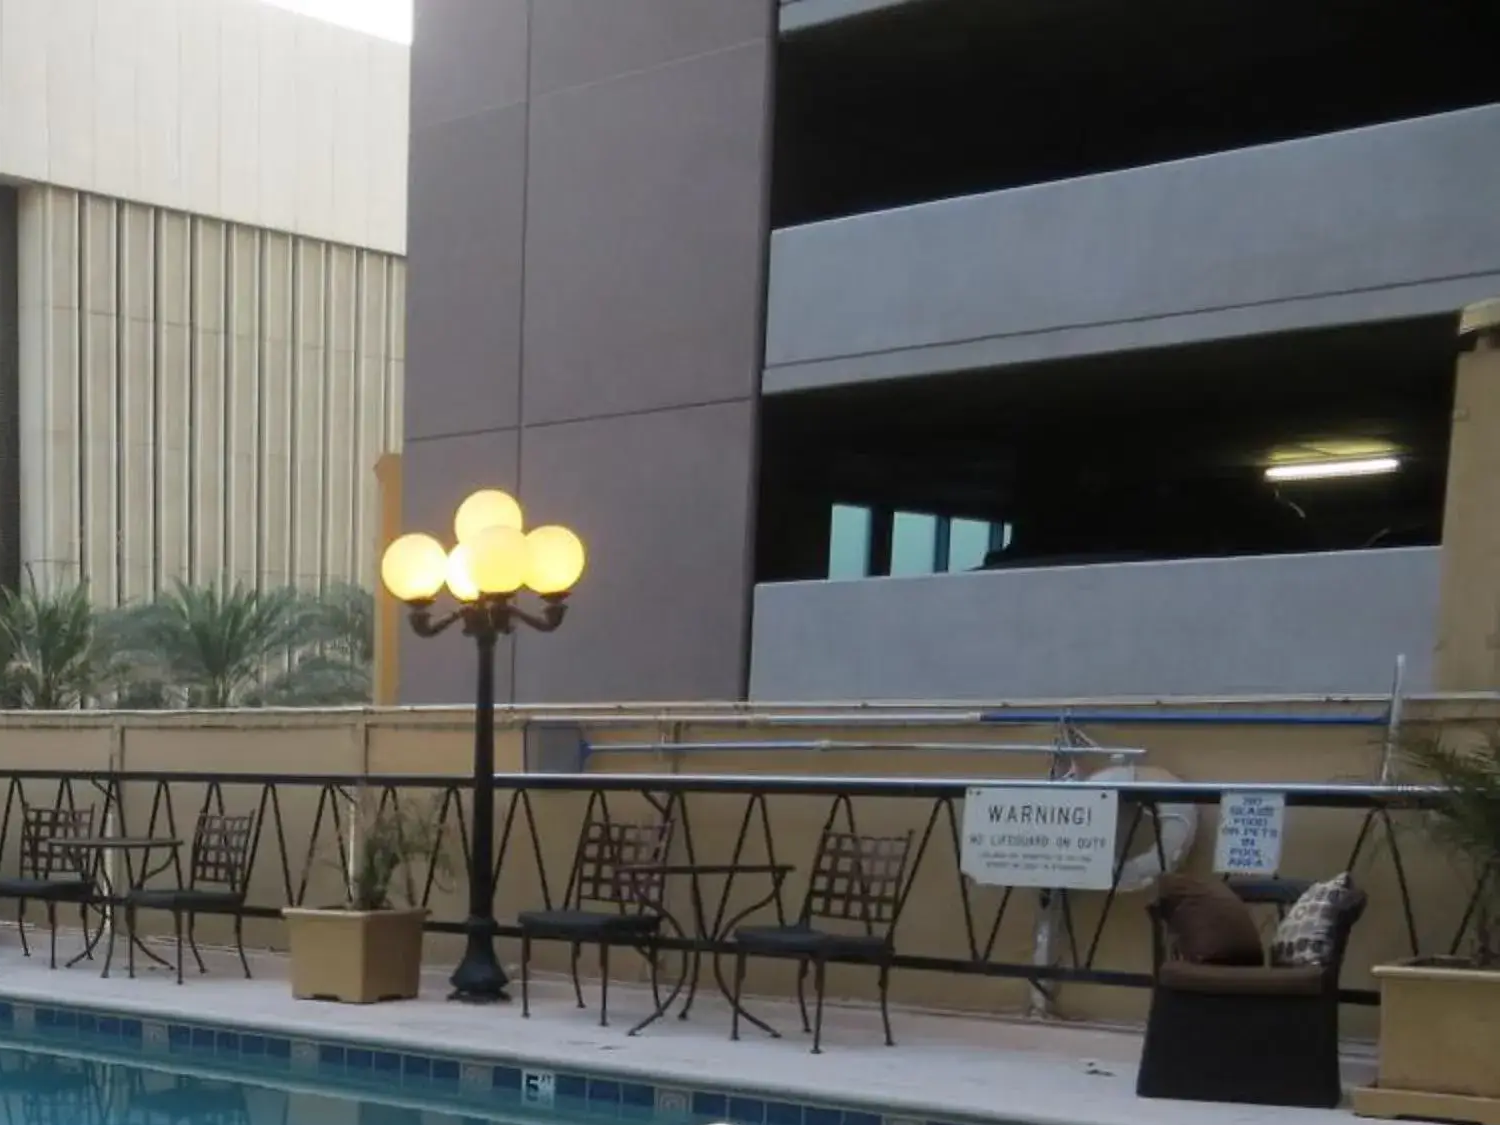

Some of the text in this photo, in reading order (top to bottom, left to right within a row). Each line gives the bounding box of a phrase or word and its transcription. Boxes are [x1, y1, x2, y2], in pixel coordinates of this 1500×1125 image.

[988, 804, 1092, 826] WARNING!
[991, 834, 1049, 848] LIFEGUARD
[1056, 836, 1071, 848] ON
